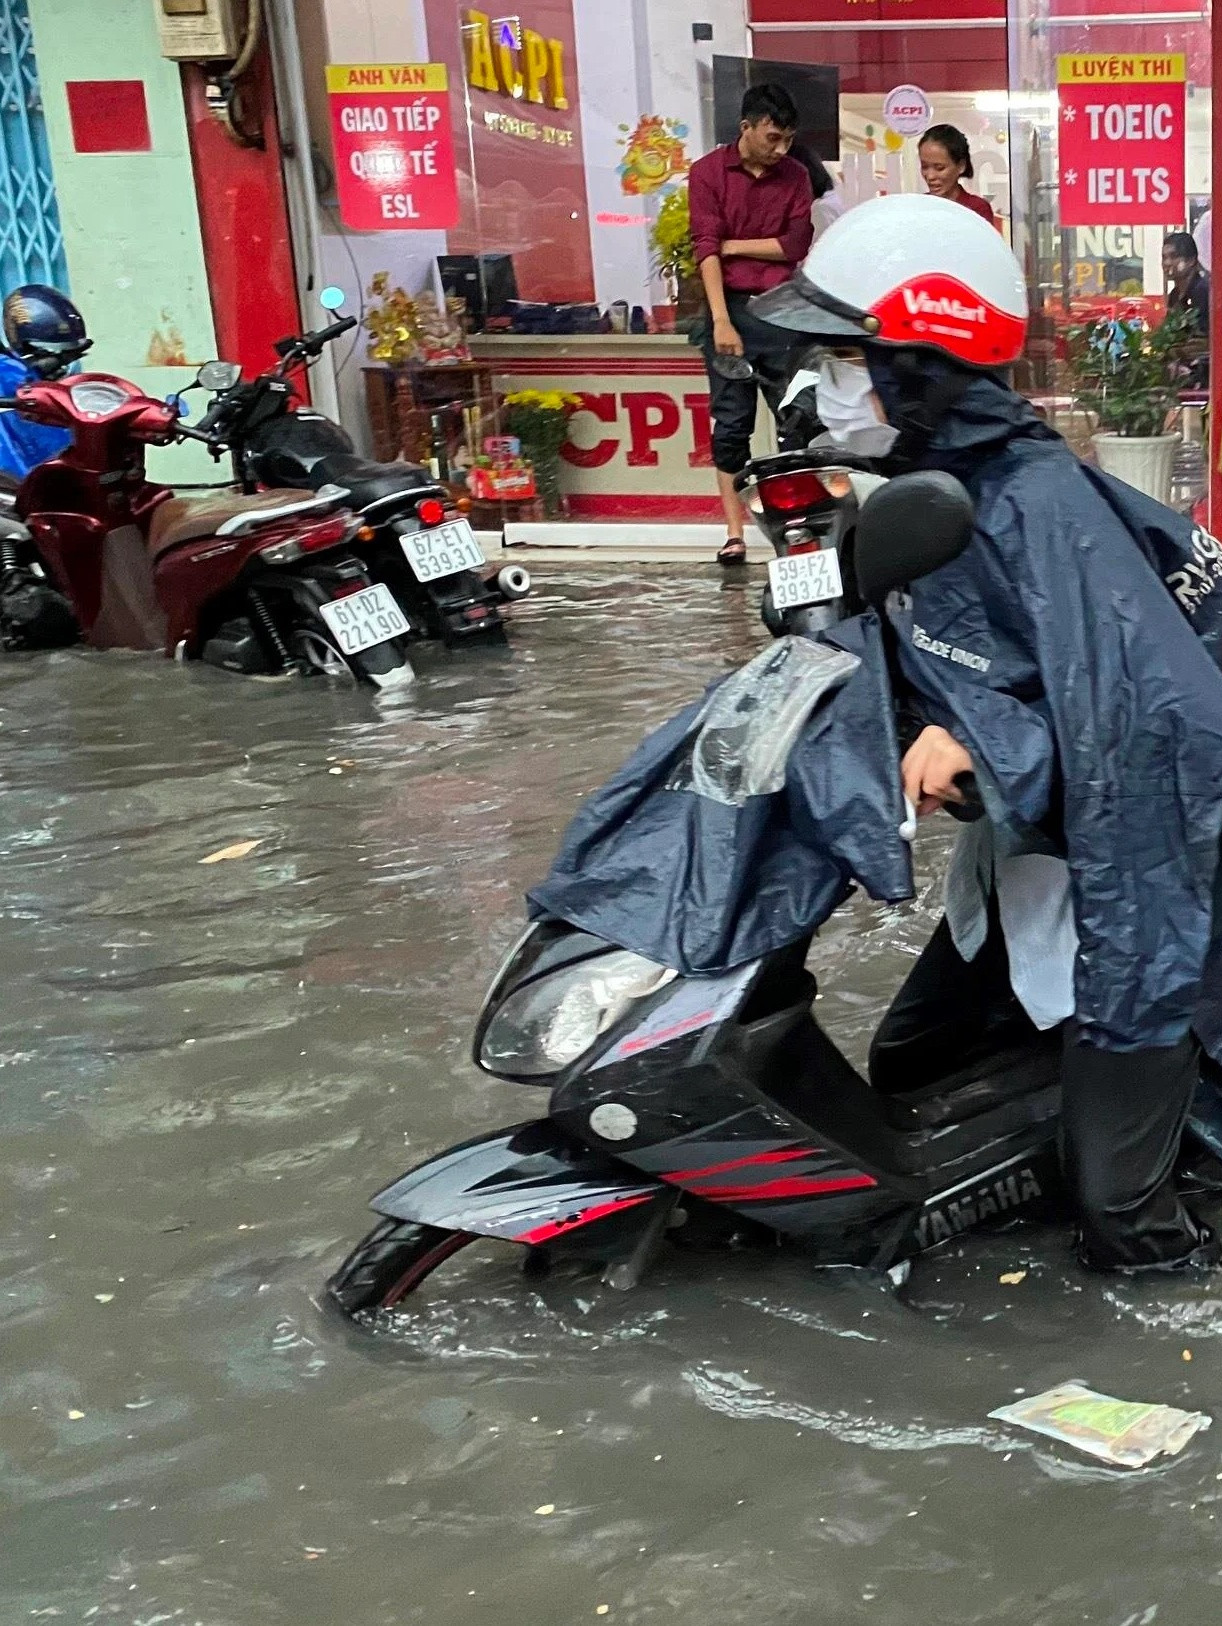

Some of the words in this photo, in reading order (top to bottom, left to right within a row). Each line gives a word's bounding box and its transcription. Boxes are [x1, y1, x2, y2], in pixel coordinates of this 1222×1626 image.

[348, 69, 384, 86] ANH
[390, 67, 426, 85] VĂN
[1072, 56, 1134, 81] LUYỆN
[1140, 59, 1171, 76] THI
[340, 106, 389, 133] GIAO
[391, 97, 441, 132] TIẾP
[892, 105, 923, 116] ACPI
[1084, 103, 1174, 141] TOEIC
[409, 141, 439, 176] TẾ
[1087, 166, 1171, 204] IELTS
[380, 193, 421, 219] ESL
[558, 391, 716, 468] CPI
[412, 526, 464, 556] 67-E1
[416, 545, 478, 577] 539.31
[777, 554, 829, 582] 59-F2
[776, 575, 836, 605] 393.24
[333, 591, 385, 625] 61-D2
[340, 611, 403, 650] 221.90
[913, 1168, 1042, 1249] YAMAHA
